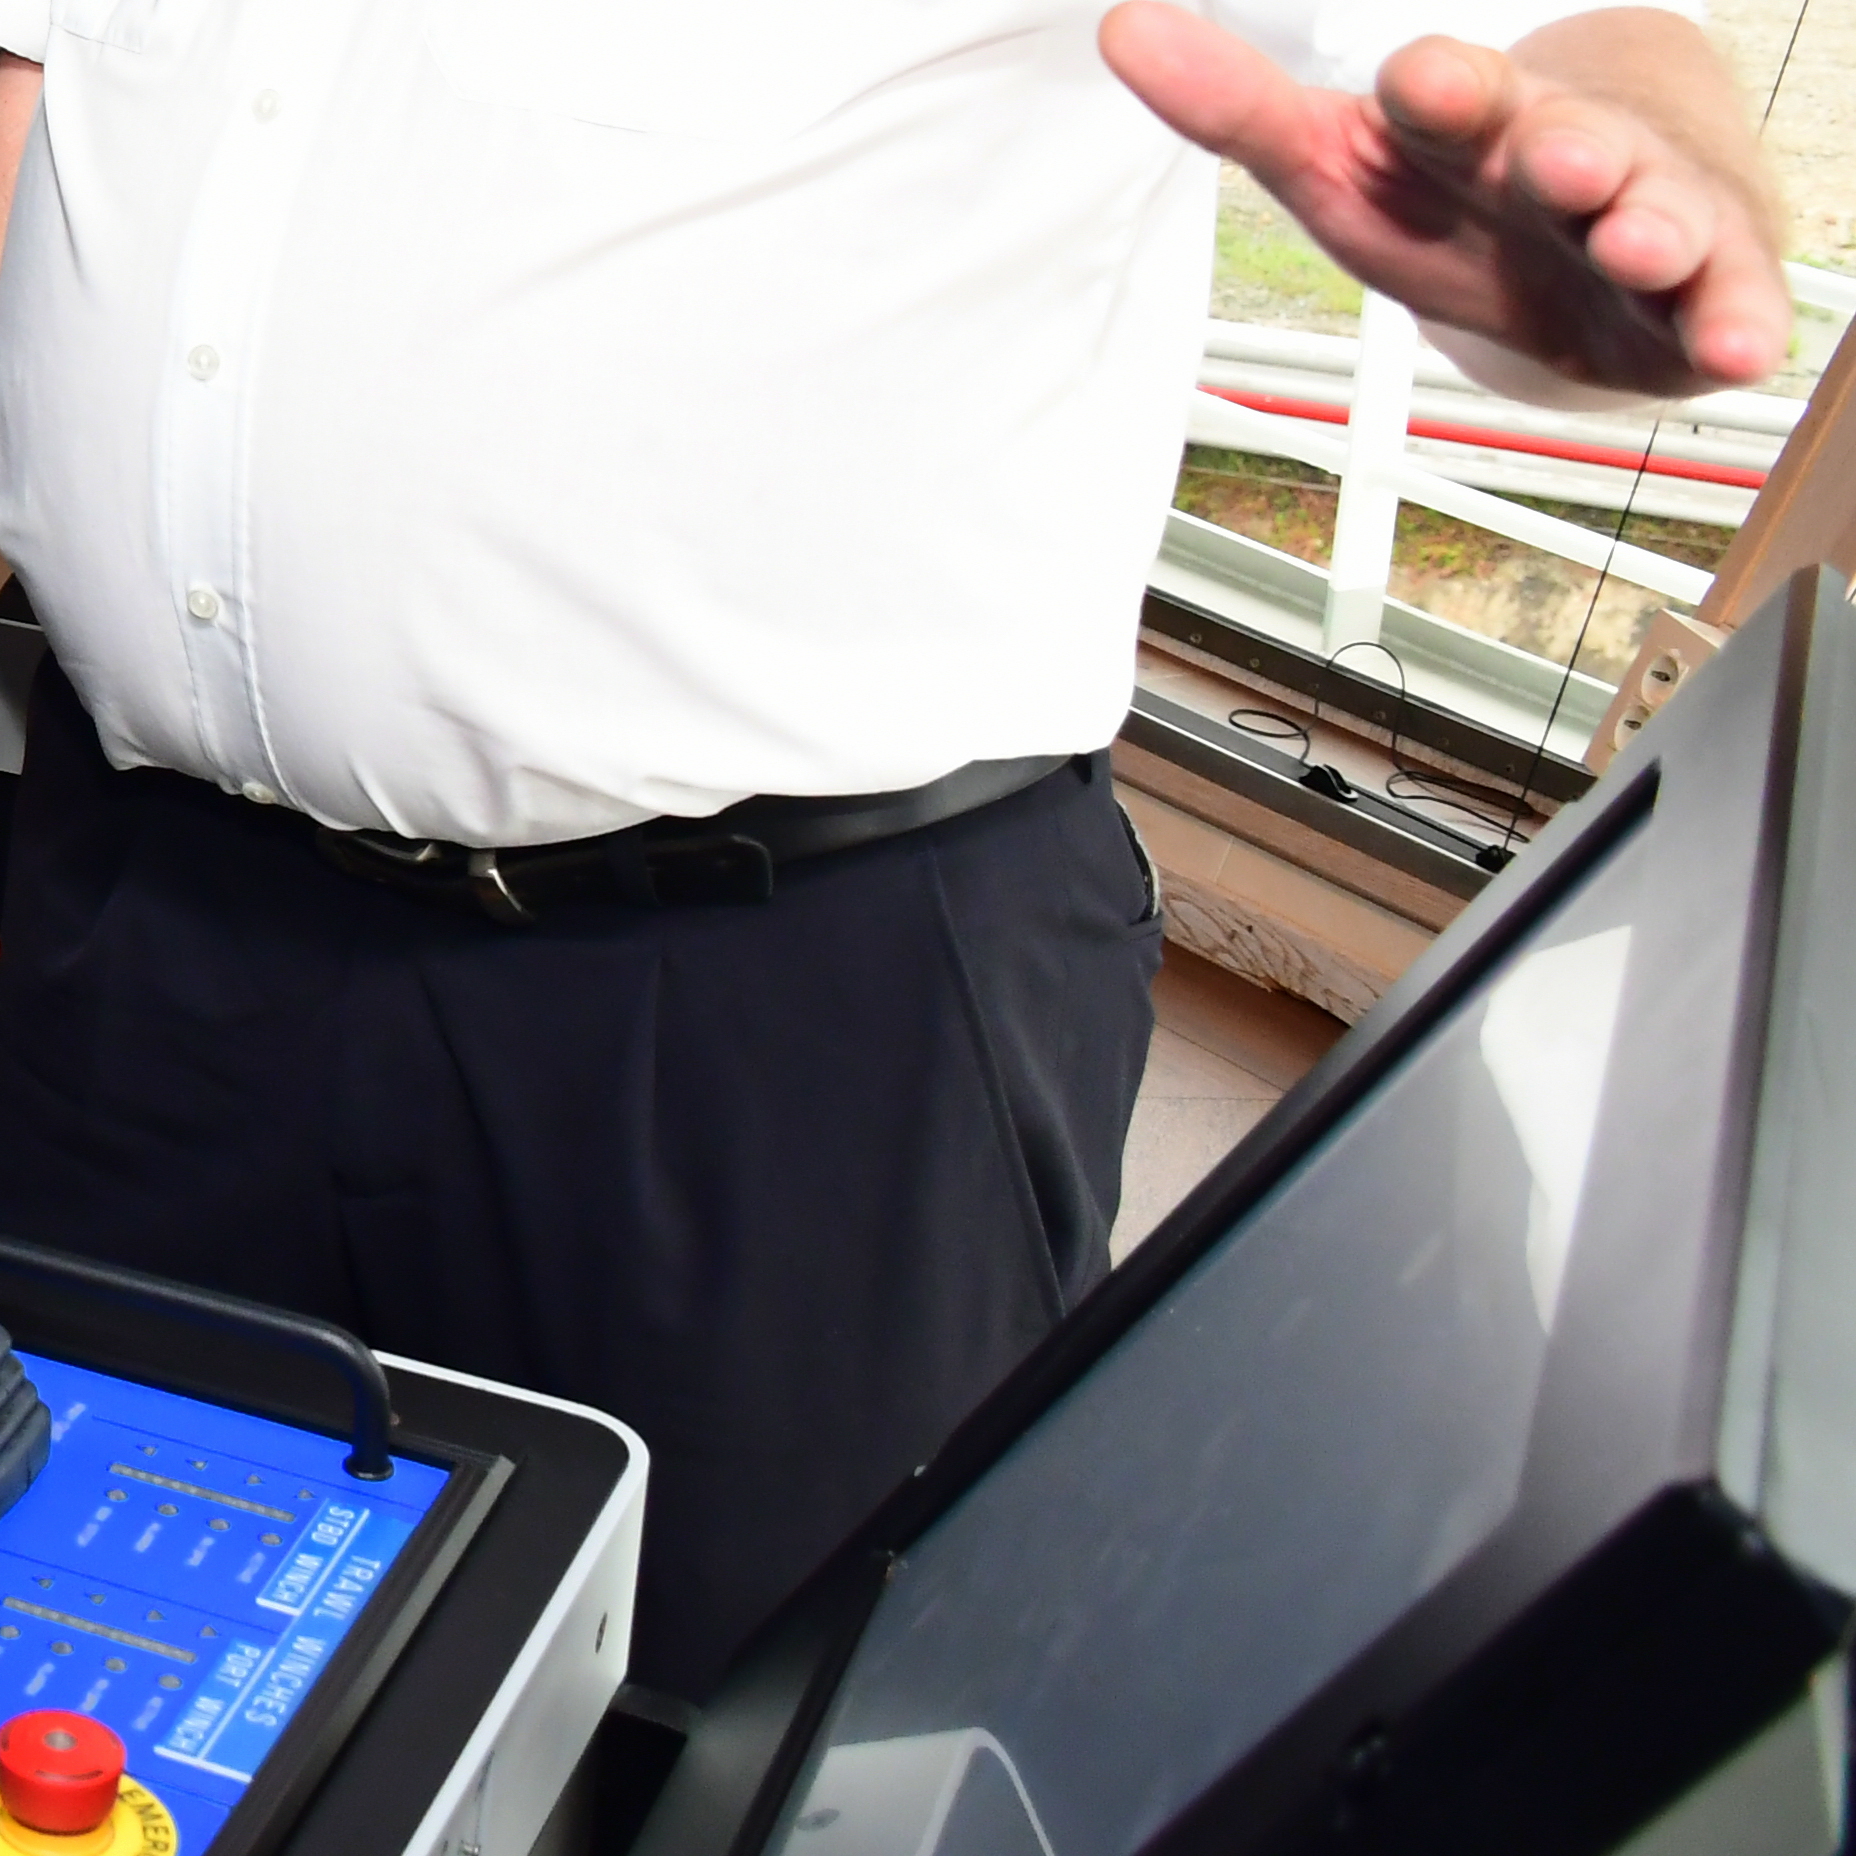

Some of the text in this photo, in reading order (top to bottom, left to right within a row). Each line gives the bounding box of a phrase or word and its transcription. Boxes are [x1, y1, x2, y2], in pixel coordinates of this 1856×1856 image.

[274, 1505, 355, 1603] STBD WINCH
[245, 1554, 382, 1728] TRAWL WINCHES
[169, 1643, 261, 1750] PORT WINCH
[118, 1785, 170, 1856] EMER
